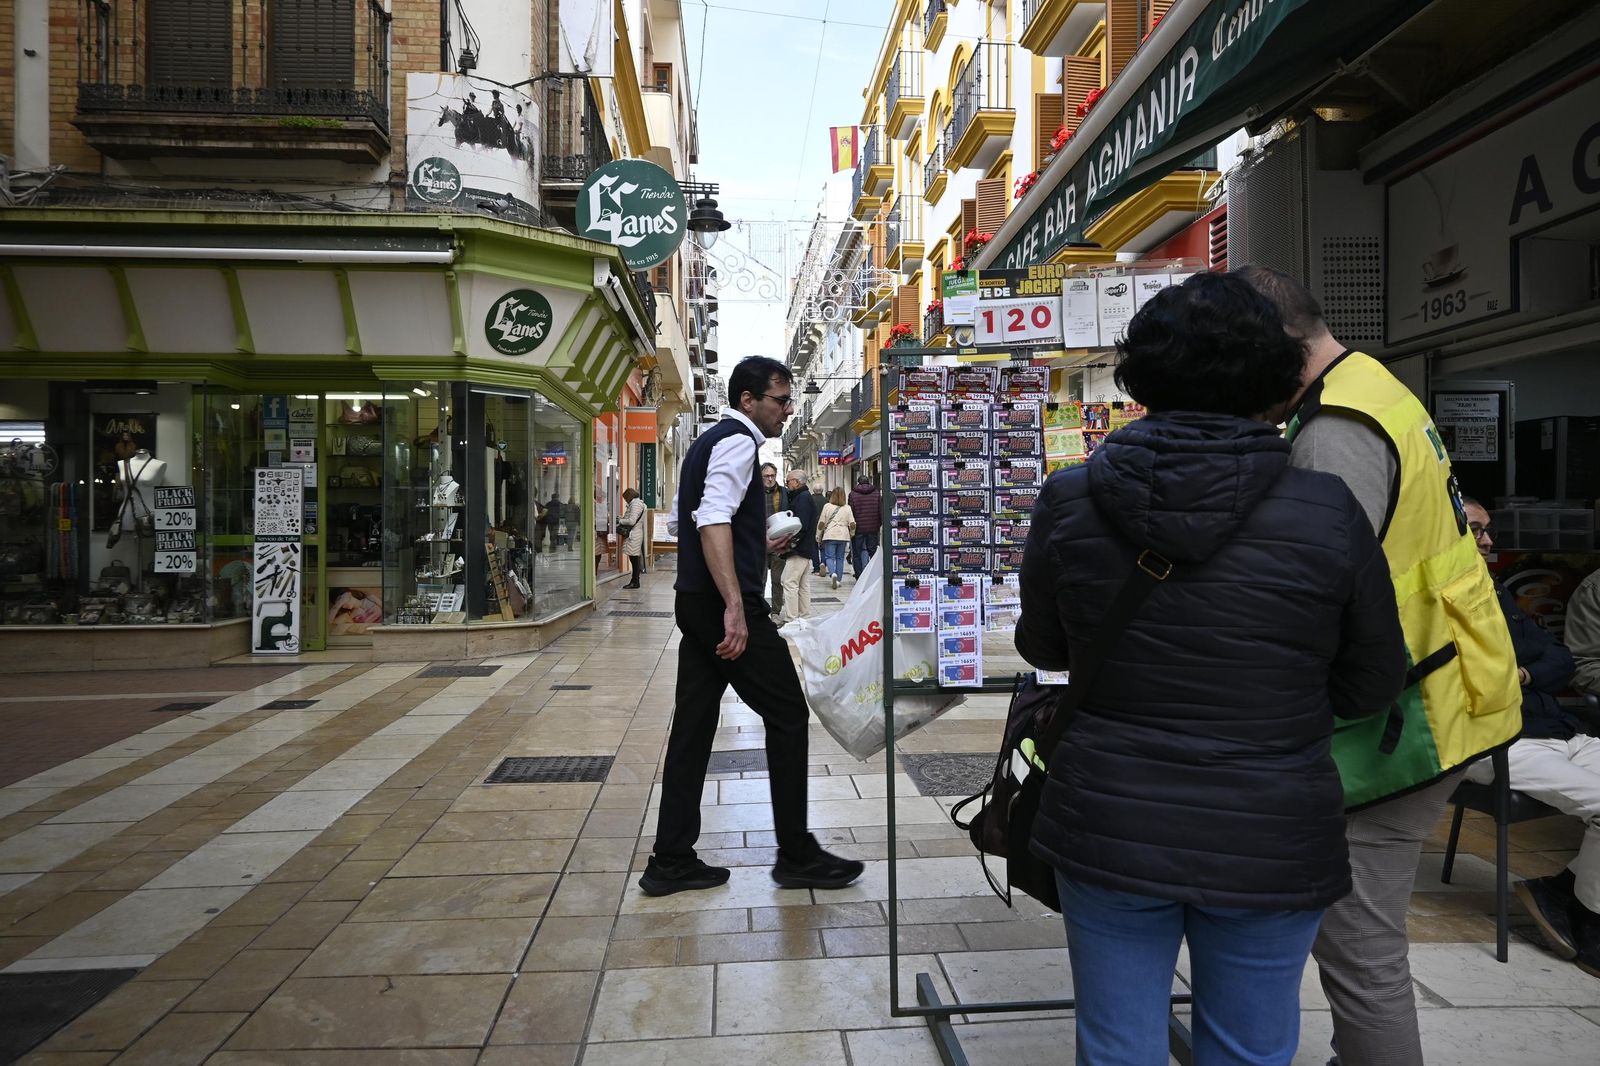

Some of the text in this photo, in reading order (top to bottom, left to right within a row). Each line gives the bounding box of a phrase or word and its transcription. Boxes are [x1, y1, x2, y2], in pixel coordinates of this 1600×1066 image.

[1006, 222, 1039, 269] CAFE
[1044, 183, 1075, 246] BAR
[1085, 46, 1199, 207] AGMANIR
[640, 186, 674, 199] Tiendas
[646, 252, 658, 263] 1915
[1028, 264, 1065, 279] EURO
[994, 287, 1010, 297] DE
[1016, 279, 1062, 294] JACKP
[1420, 290, 1466, 323] 1963
[157, 488, 192, 498] BLACK
[158, 497, 192, 506] FRIDAY
[166, 512, 192, 526] 20%
[158, 532, 192, 541] BLACK
[158, 540, 193, 549] FRIDAY
[166, 555, 192, 569] 20%
